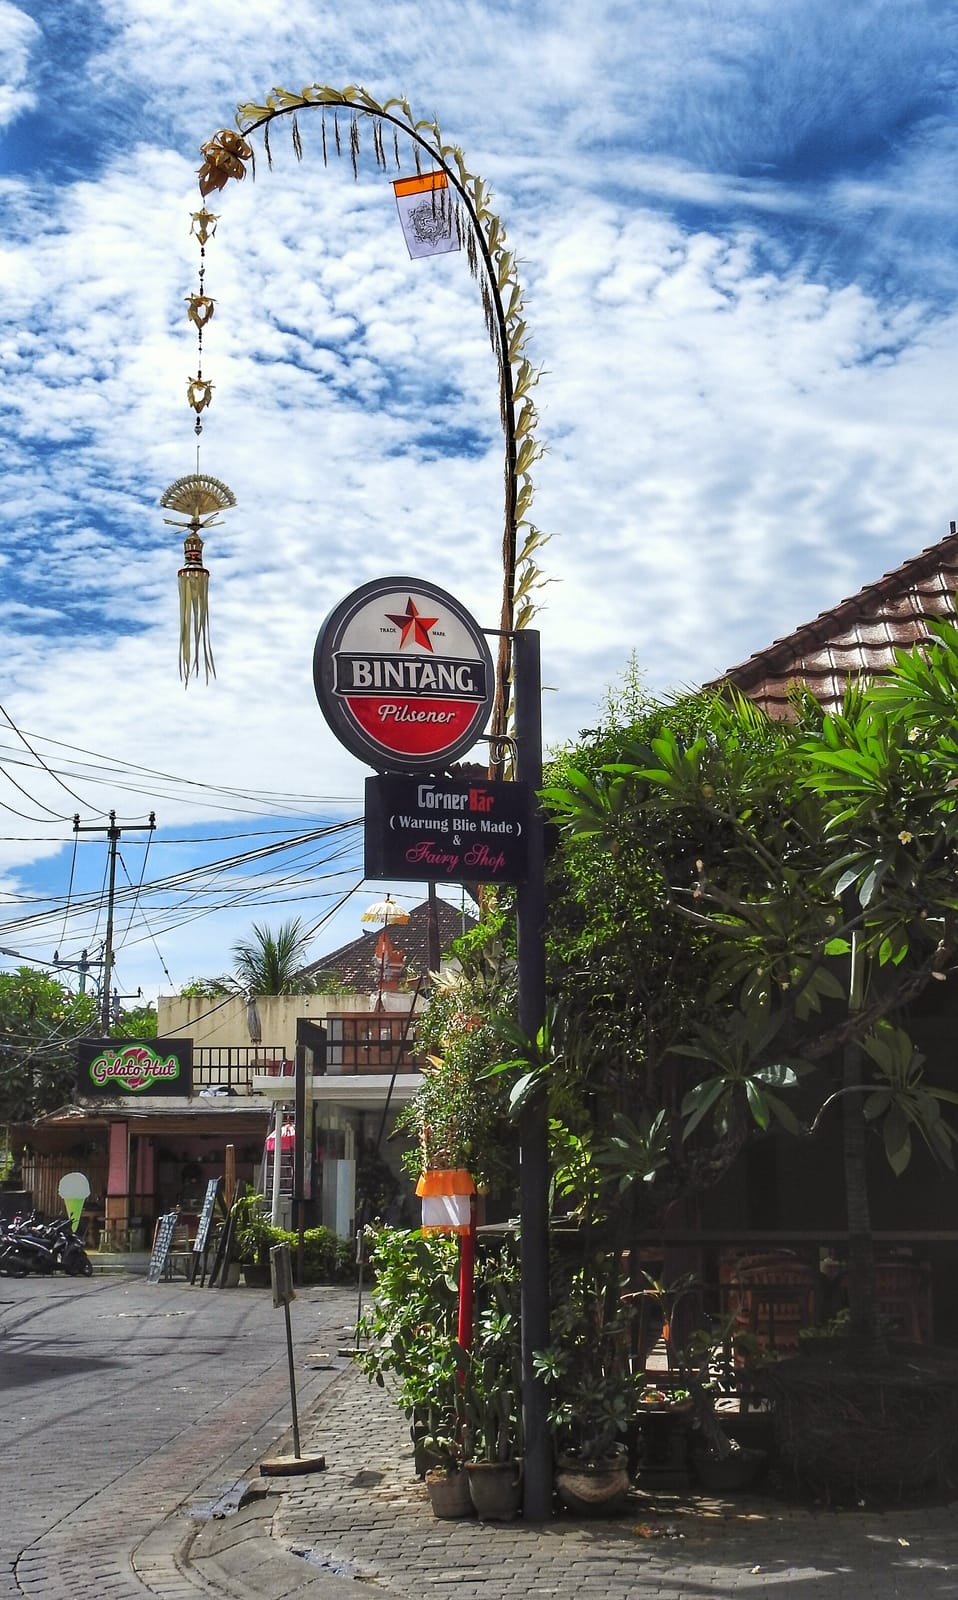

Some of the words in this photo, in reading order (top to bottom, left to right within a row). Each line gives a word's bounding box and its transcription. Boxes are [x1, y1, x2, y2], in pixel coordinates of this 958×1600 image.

[351, 660, 474, 692] BINTANG
[378, 704, 456, 723] Pilsener
[452, 818, 477, 832] Blie
[480, 820, 513, 834] Made
[452, 834, 461, 846] &
[405, 841, 460, 873] Fairy
[463, 843, 506, 873] Shop
[93, 1058, 142, 1082] Gelato
[142, 1058, 176, 1077] Hut
